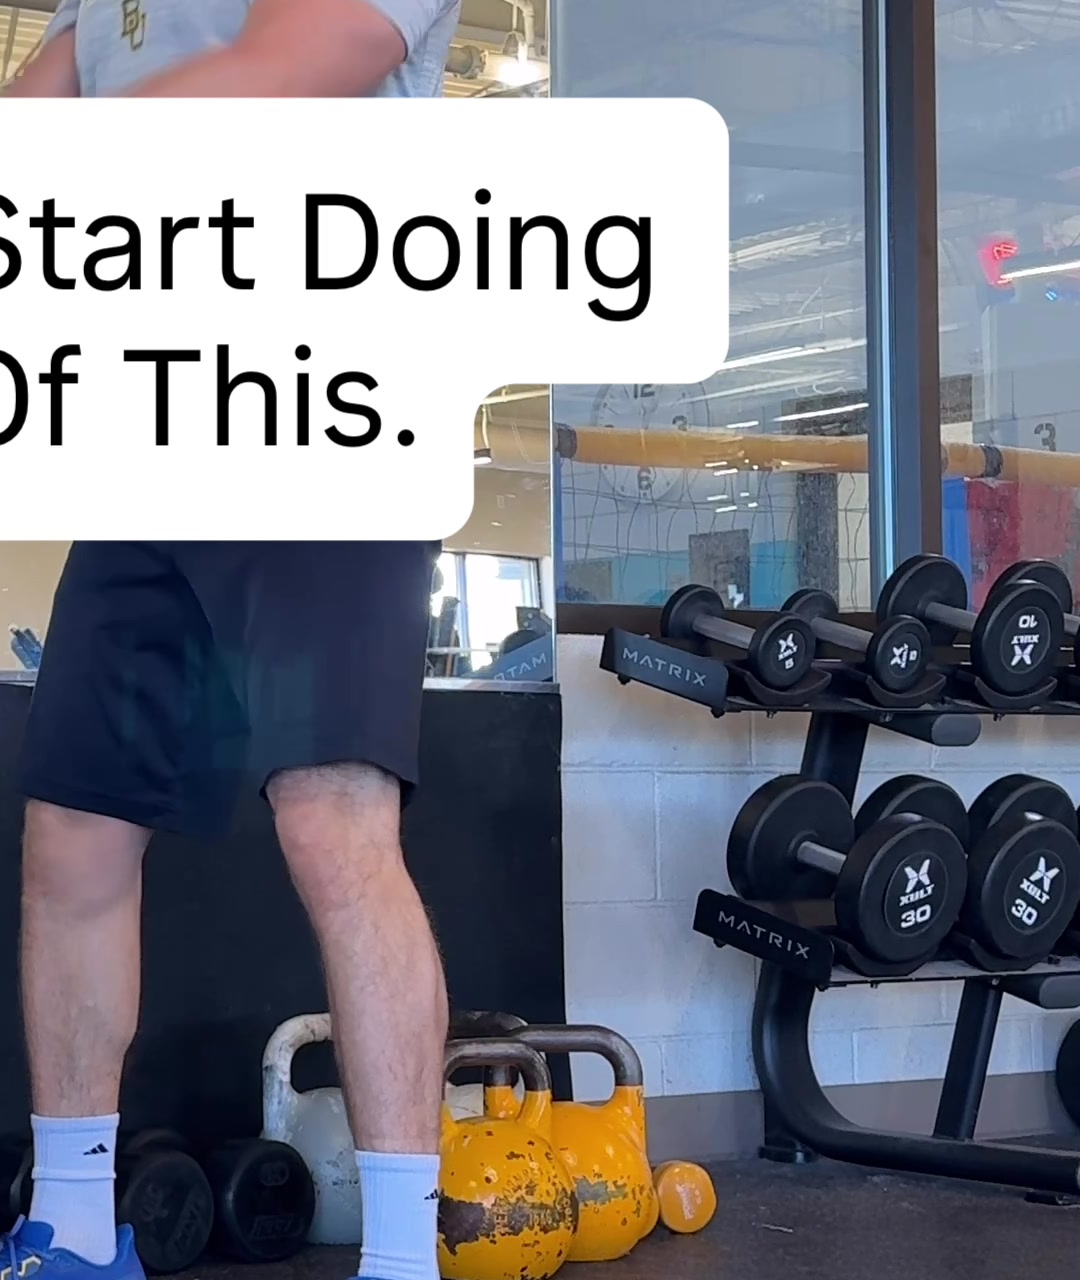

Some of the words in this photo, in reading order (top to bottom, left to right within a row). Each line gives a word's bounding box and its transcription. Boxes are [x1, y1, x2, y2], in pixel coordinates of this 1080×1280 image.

[1018, 614, 1038, 628] 10
[622, 647, 708, 687] MATRIX
[899, 884, 935, 907] XULT
[1020, 878, 1050, 905] XULT
[900, 904, 931, 929] 30
[1011, 898, 1038, 926] 30
[718, 910, 810, 959] MATRIX
